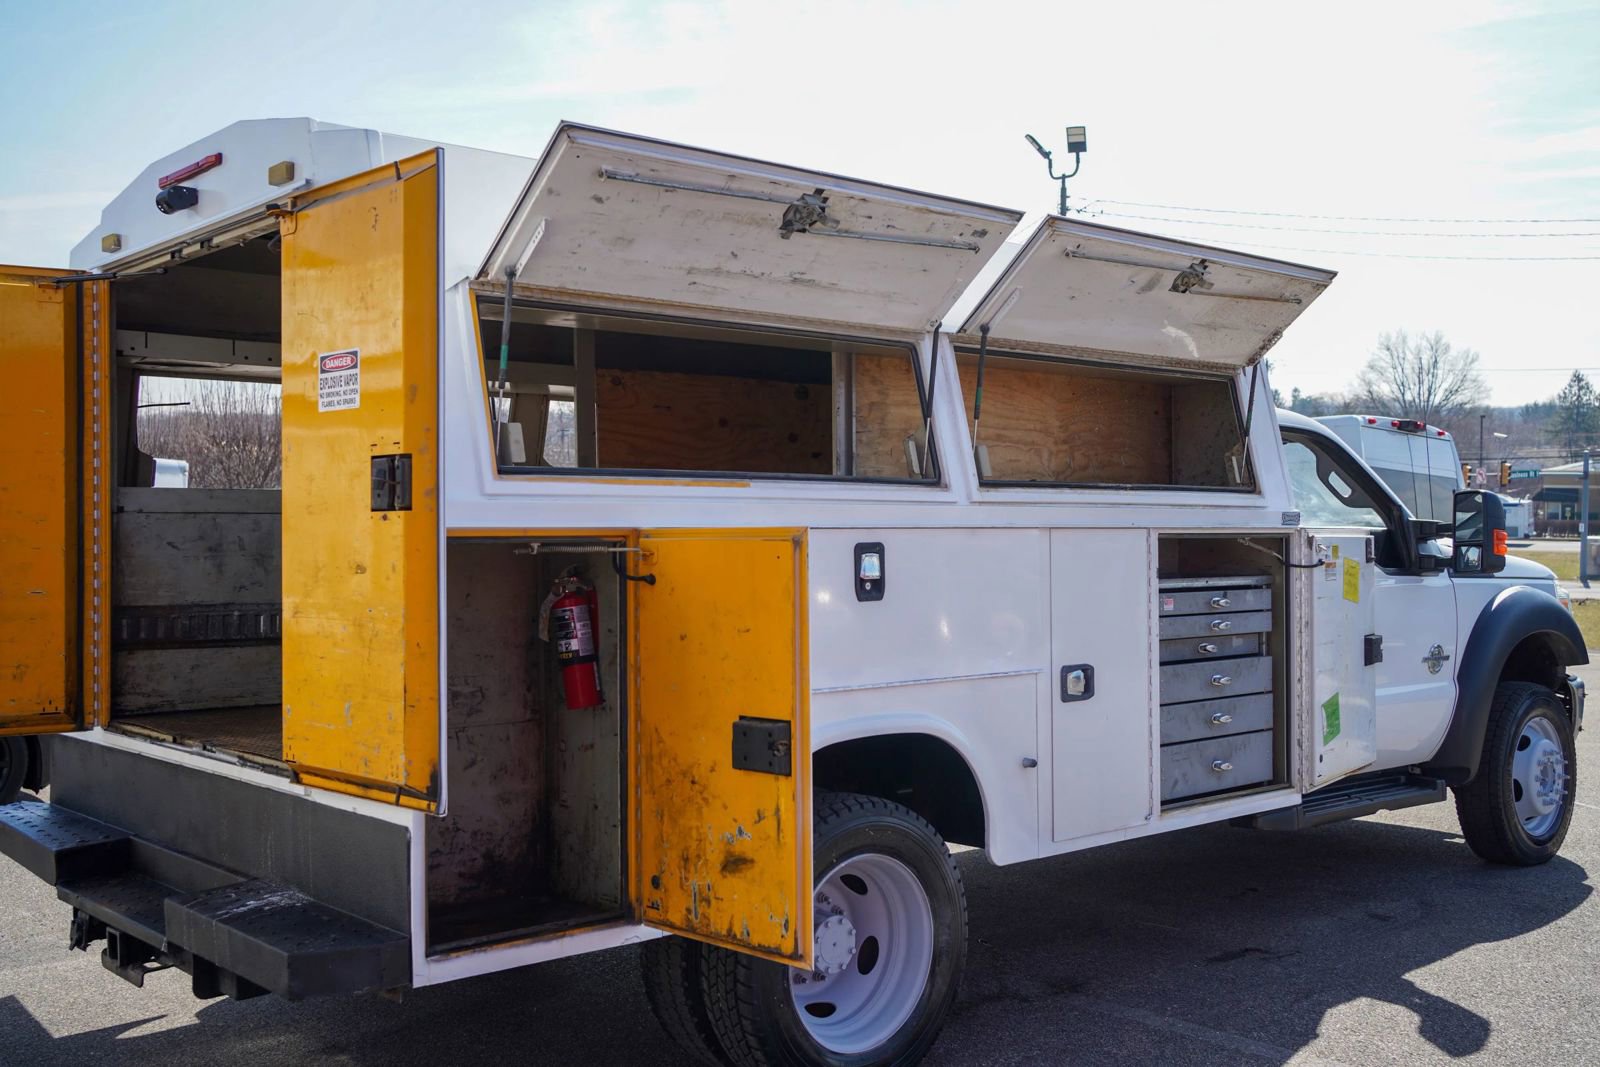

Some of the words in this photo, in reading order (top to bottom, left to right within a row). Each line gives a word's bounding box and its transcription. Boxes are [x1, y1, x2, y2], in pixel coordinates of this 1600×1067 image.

[326, 356, 352, 368] DANGER
[320, 375, 343, 390] EXPLOSIVE
[344, 372, 358, 387] VAPOR
[348, 388, 358, 396] OPEN
[342, 397, 356, 405] SPARKS
